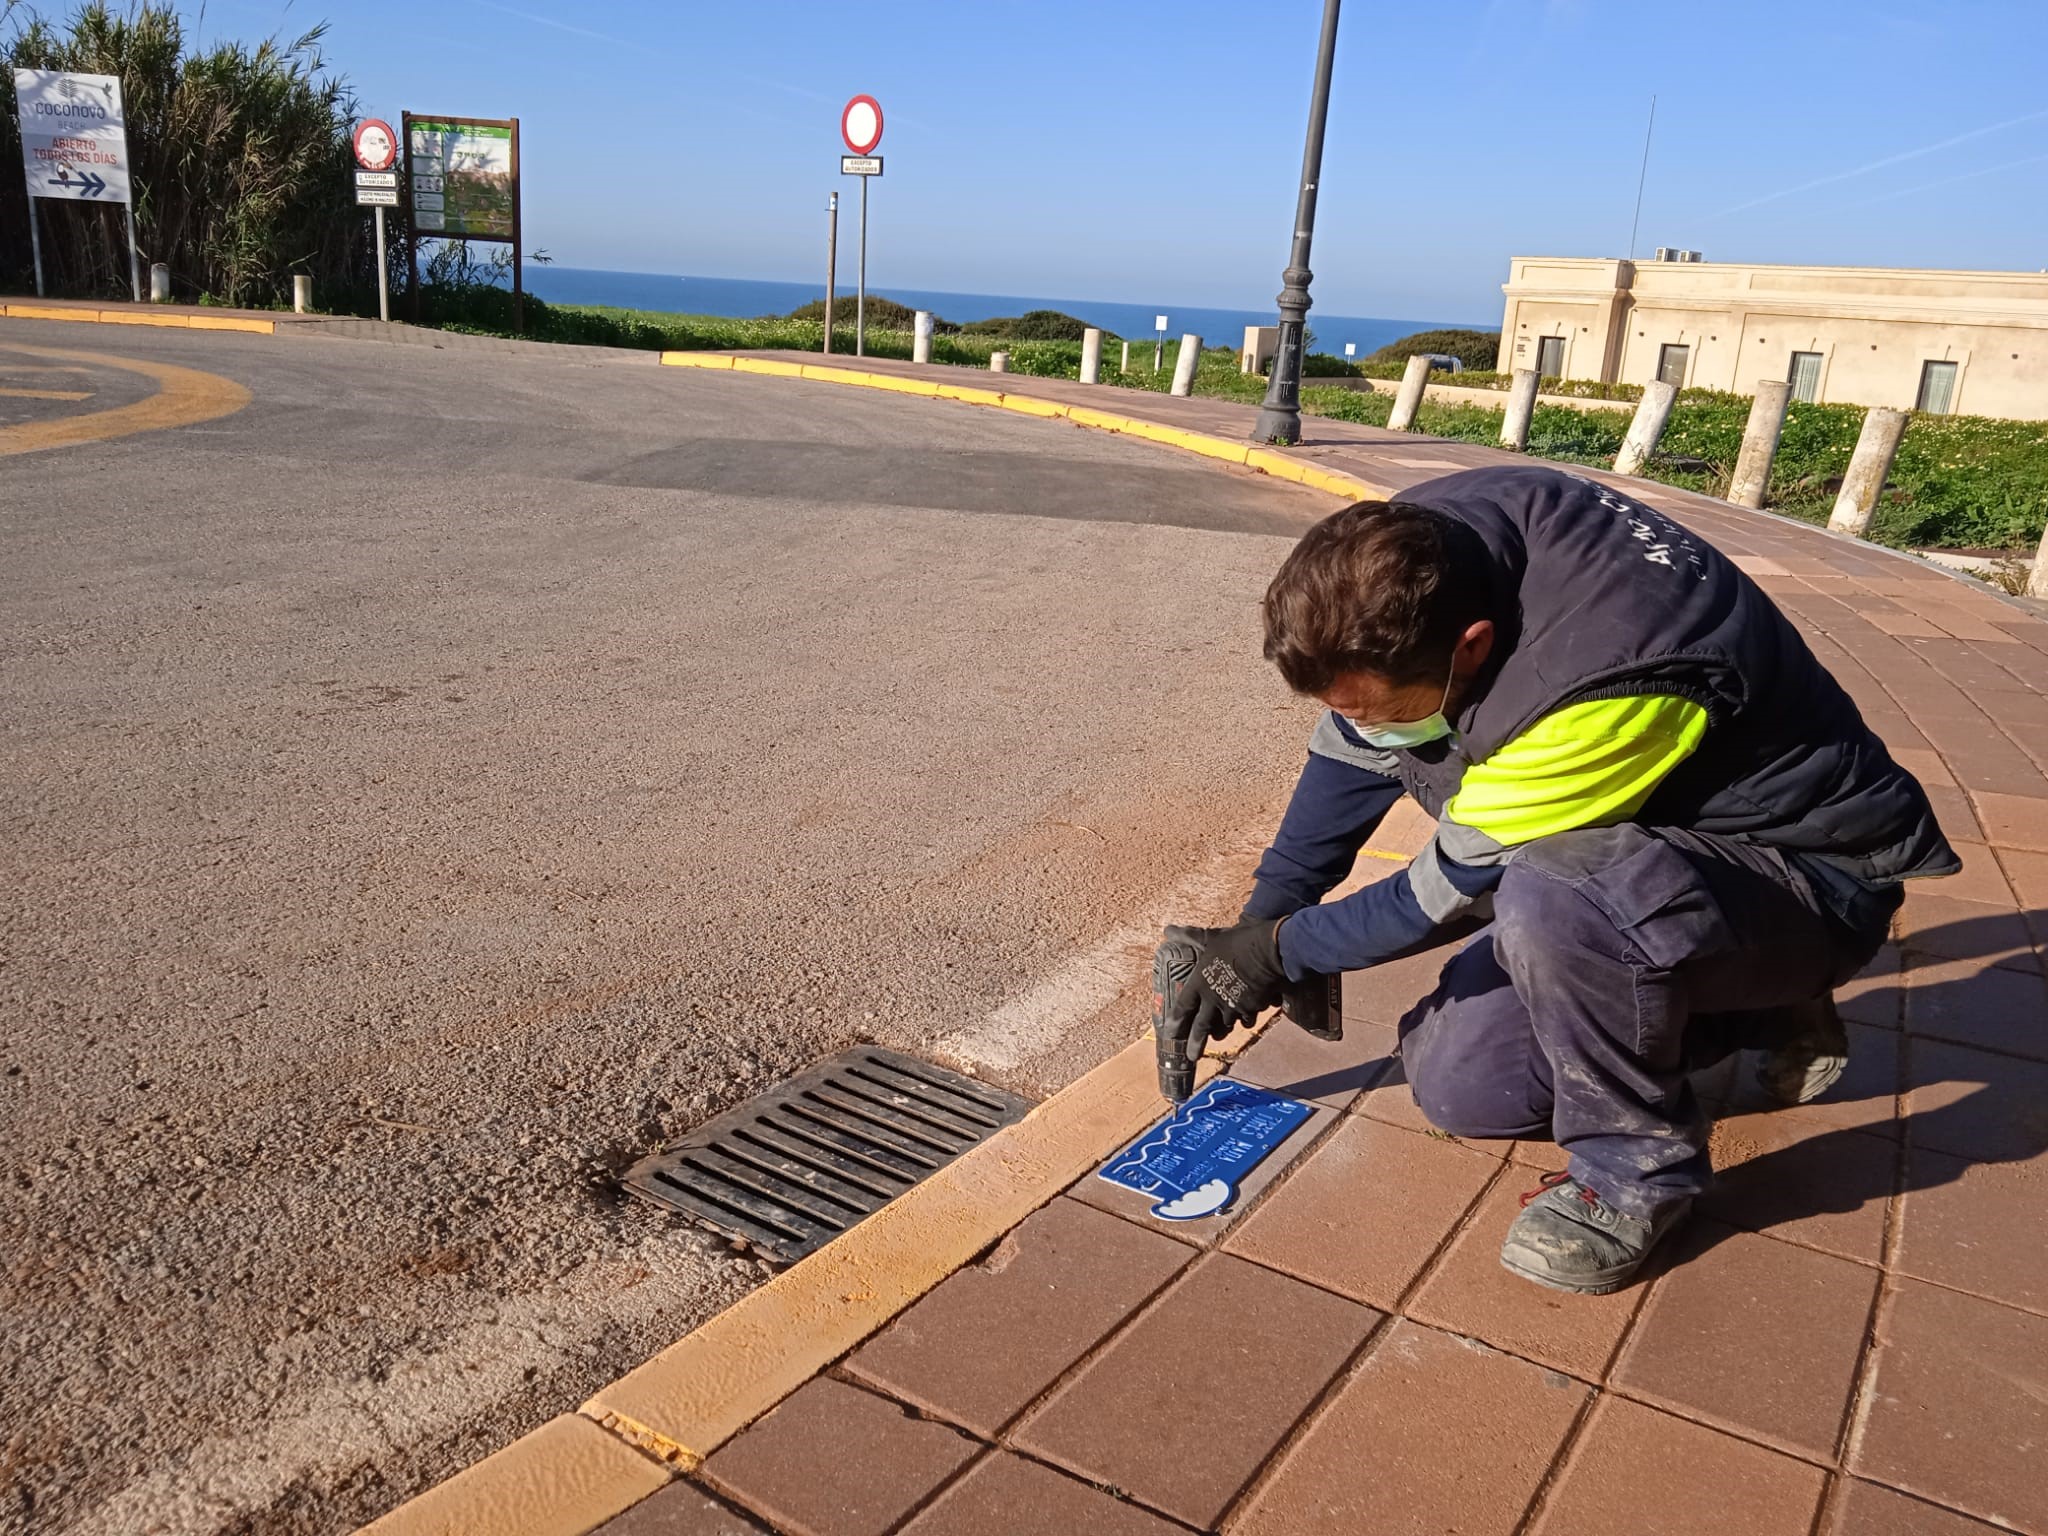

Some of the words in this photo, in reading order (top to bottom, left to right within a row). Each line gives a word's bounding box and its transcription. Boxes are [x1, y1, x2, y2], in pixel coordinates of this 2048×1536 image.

[58, 121, 87, 129] BEACH
[52, 137, 96, 150] ABIERTO
[33, 149, 68, 161] TODOS
[71, 151, 91, 162] LOS
[94, 151, 117, 165] DÍAS
